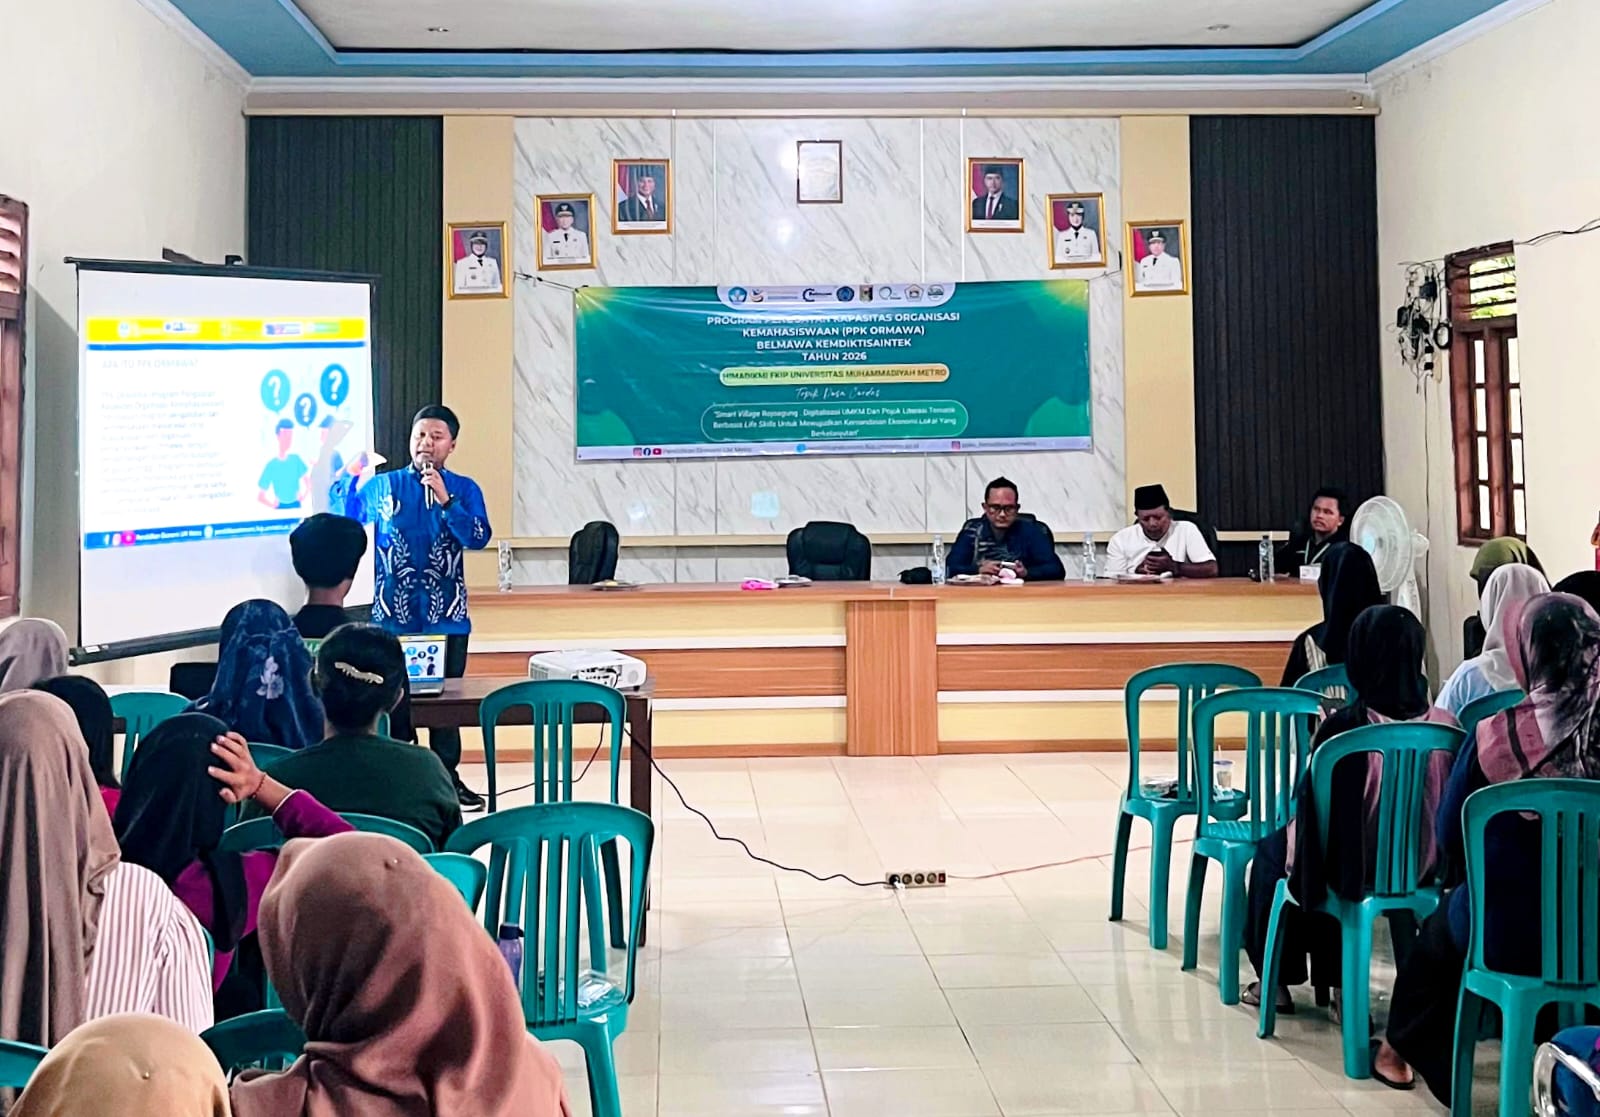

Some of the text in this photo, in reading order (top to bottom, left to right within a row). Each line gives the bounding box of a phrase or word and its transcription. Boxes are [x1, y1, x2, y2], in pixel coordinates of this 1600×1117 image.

[895, 312, 960, 322] ORGANISASI
[743, 325, 925, 337] KEMAHASISWAAN (PPK ORMAWA)
[757, 338, 912, 350] BELMAWA KEMDIKTISAINTEK
[802, 352, 867, 361] TAHUN 2026
[770, 371, 788, 379] FKIP
[790, 369, 844, 378] UNIVERSITAS
[846, 369, 916, 378] MUHAMMADIYAH
[917, 368, 947, 377] METRO
